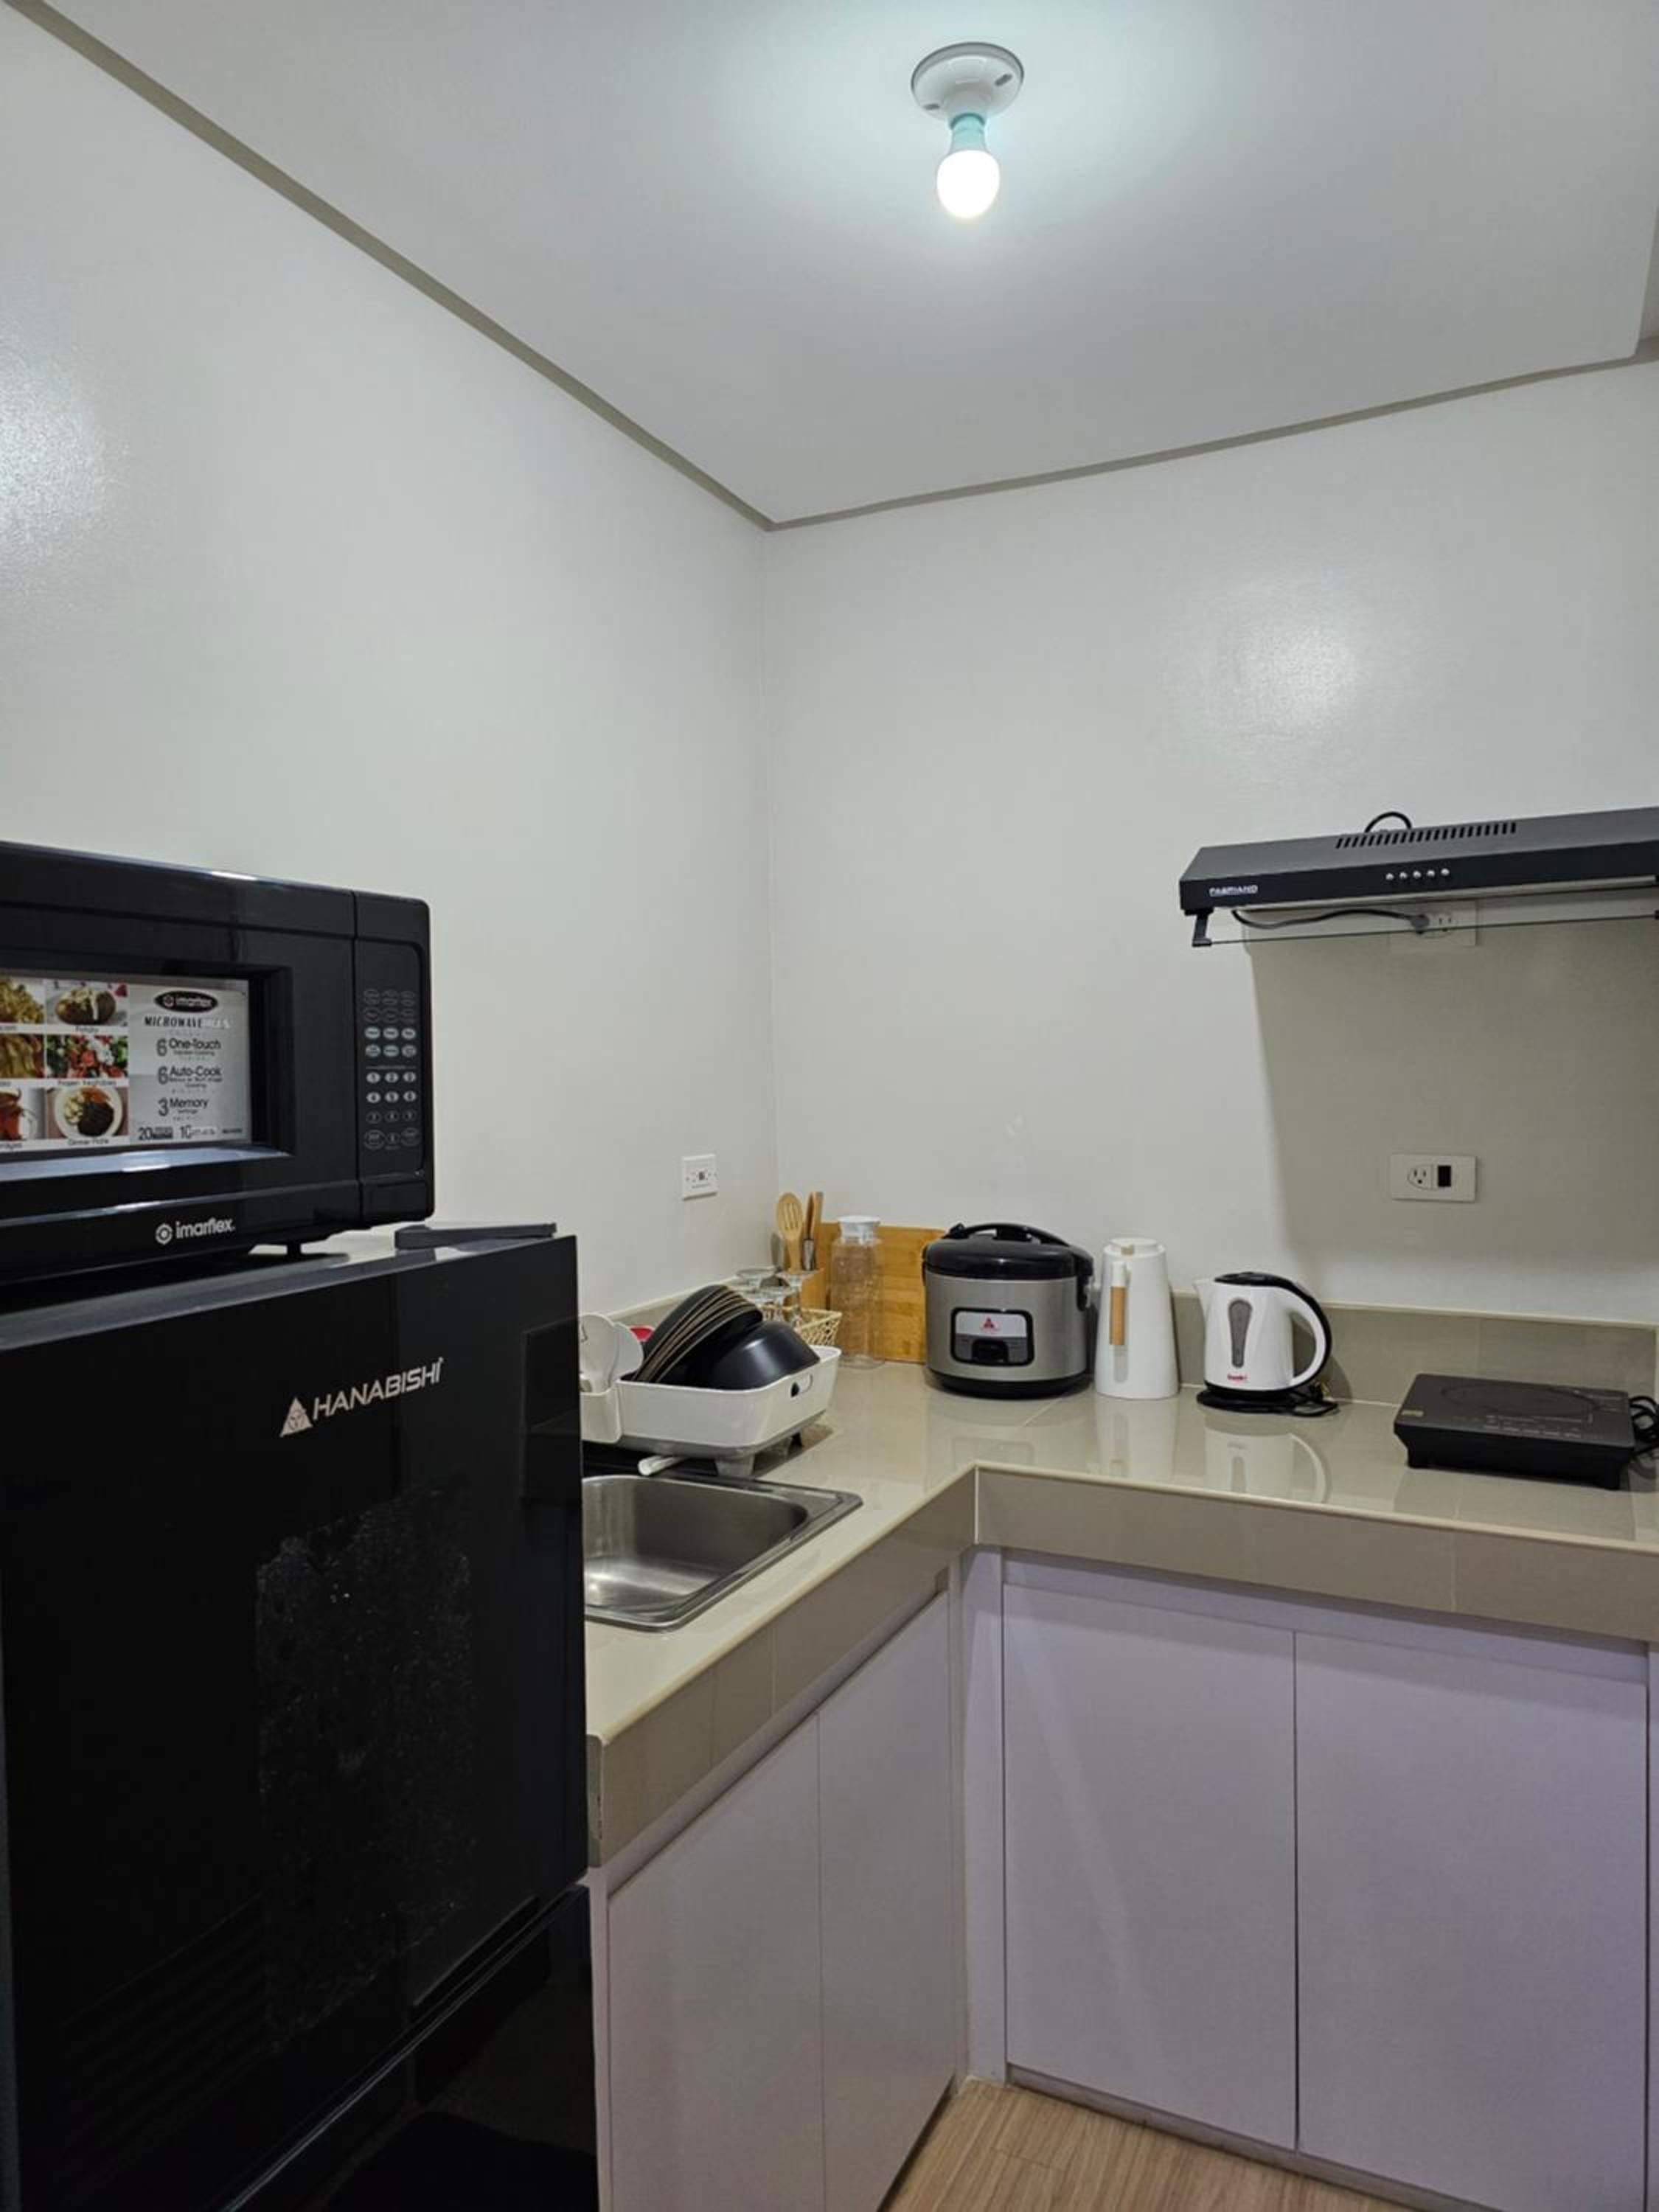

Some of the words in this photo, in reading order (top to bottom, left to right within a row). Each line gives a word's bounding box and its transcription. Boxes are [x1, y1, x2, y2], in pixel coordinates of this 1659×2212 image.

[144, 1016, 202, 1028] MICROWAVE
[156, 1037, 168, 1057] 6
[168, 1037, 222, 1051] One-Touch
[158, 1065, 169, 1085] 6
[169, 1065, 223, 1077] Auto-Cook
[158, 1097, 169, 1117] 3
[169, 1098, 209, 1110] Memory
[176, 1217, 234, 1239] imarflex
[312, 1361, 442, 1421] HANABISHI
